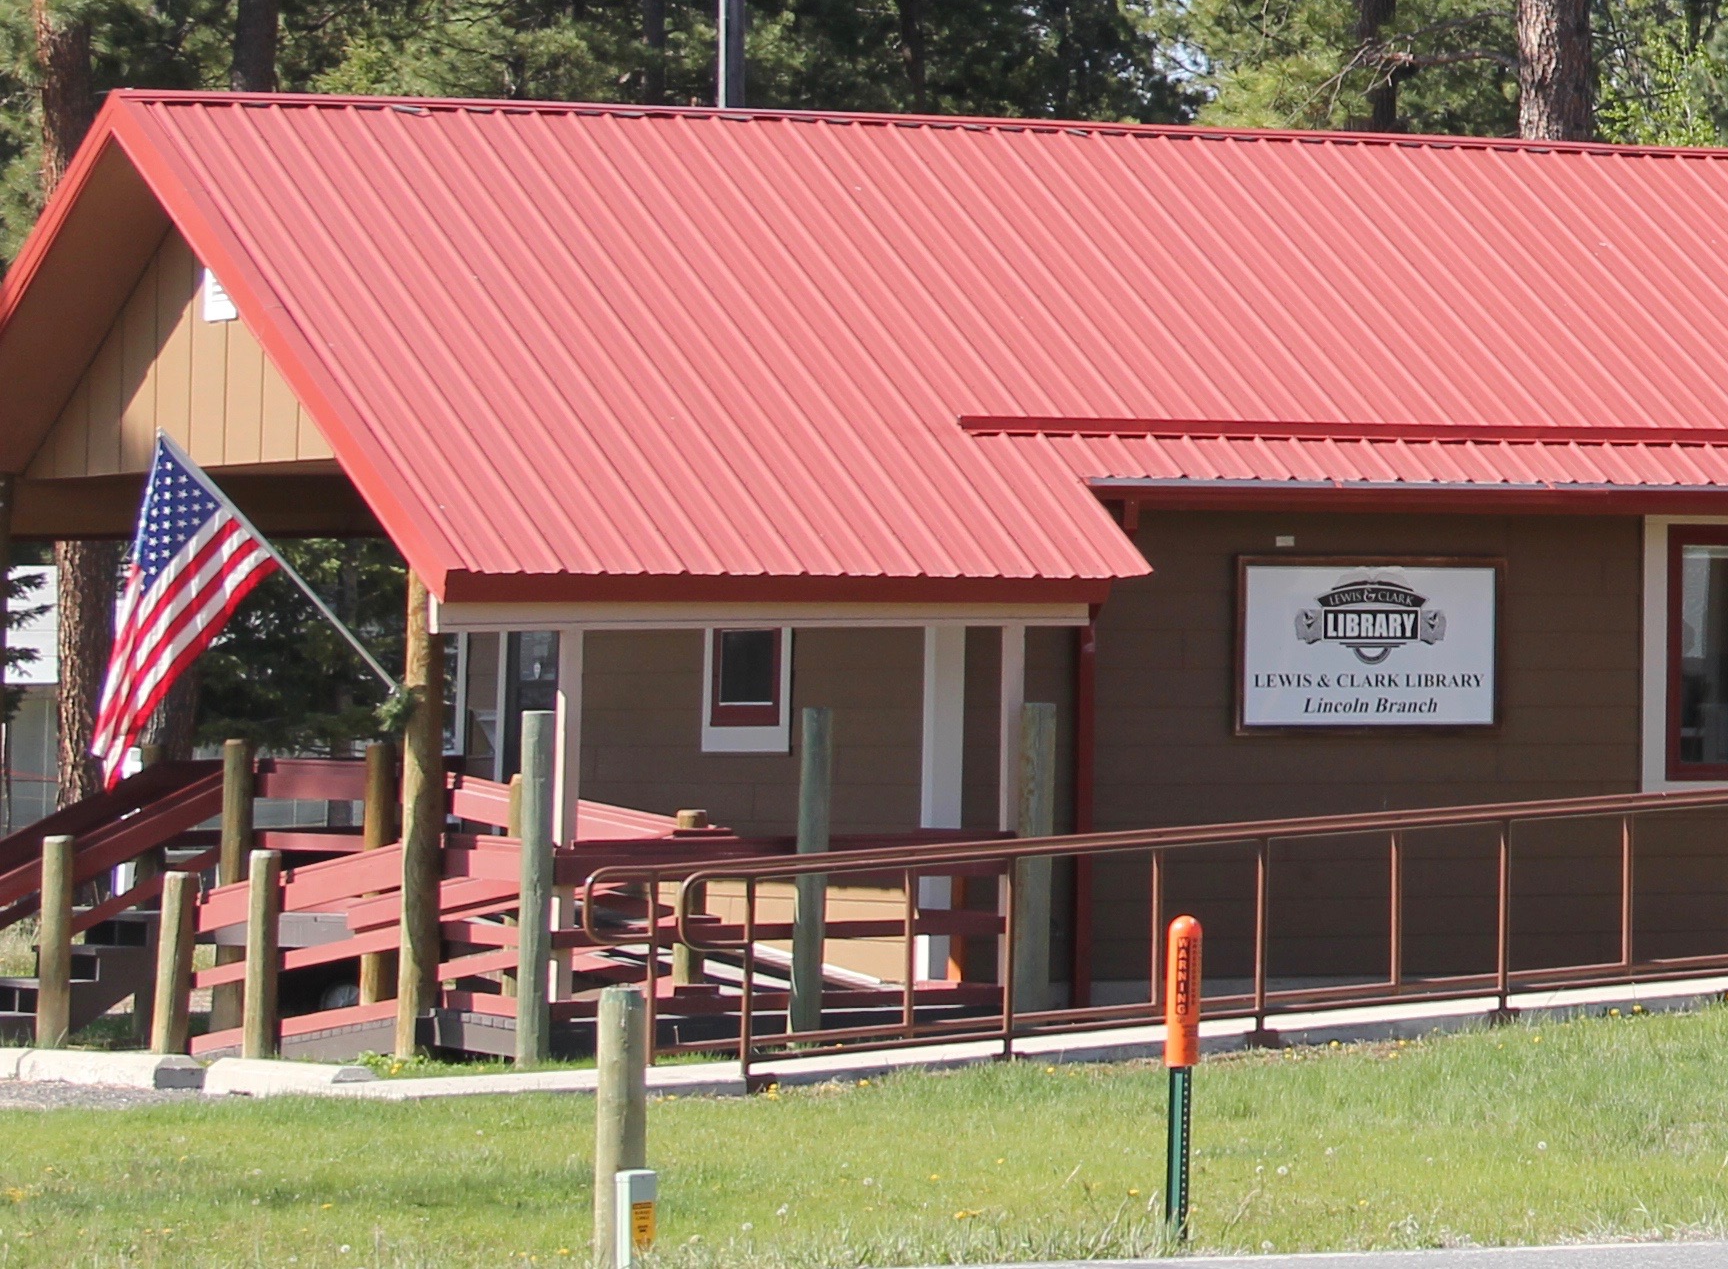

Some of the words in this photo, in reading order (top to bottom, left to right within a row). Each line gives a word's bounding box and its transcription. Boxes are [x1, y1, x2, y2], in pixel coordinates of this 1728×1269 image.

[1329, 591, 1361, 606] LEWIS
[1363, 588, 1376, 603] &
[1378, 591, 1414, 606] CLARK
[1327, 613, 1415, 637] LIBRARY
[1254, 673, 1312, 688] LEWIS
[1317, 673, 1330, 688] &
[1336, 673, 1399, 688] CLARK
[1405, 673, 1484, 688] LIBRARY
[1303, 697, 1369, 714] Lincoln
[1375, 697, 1438, 714] Branch
[1177, 937, 1190, 1015] WARNING
